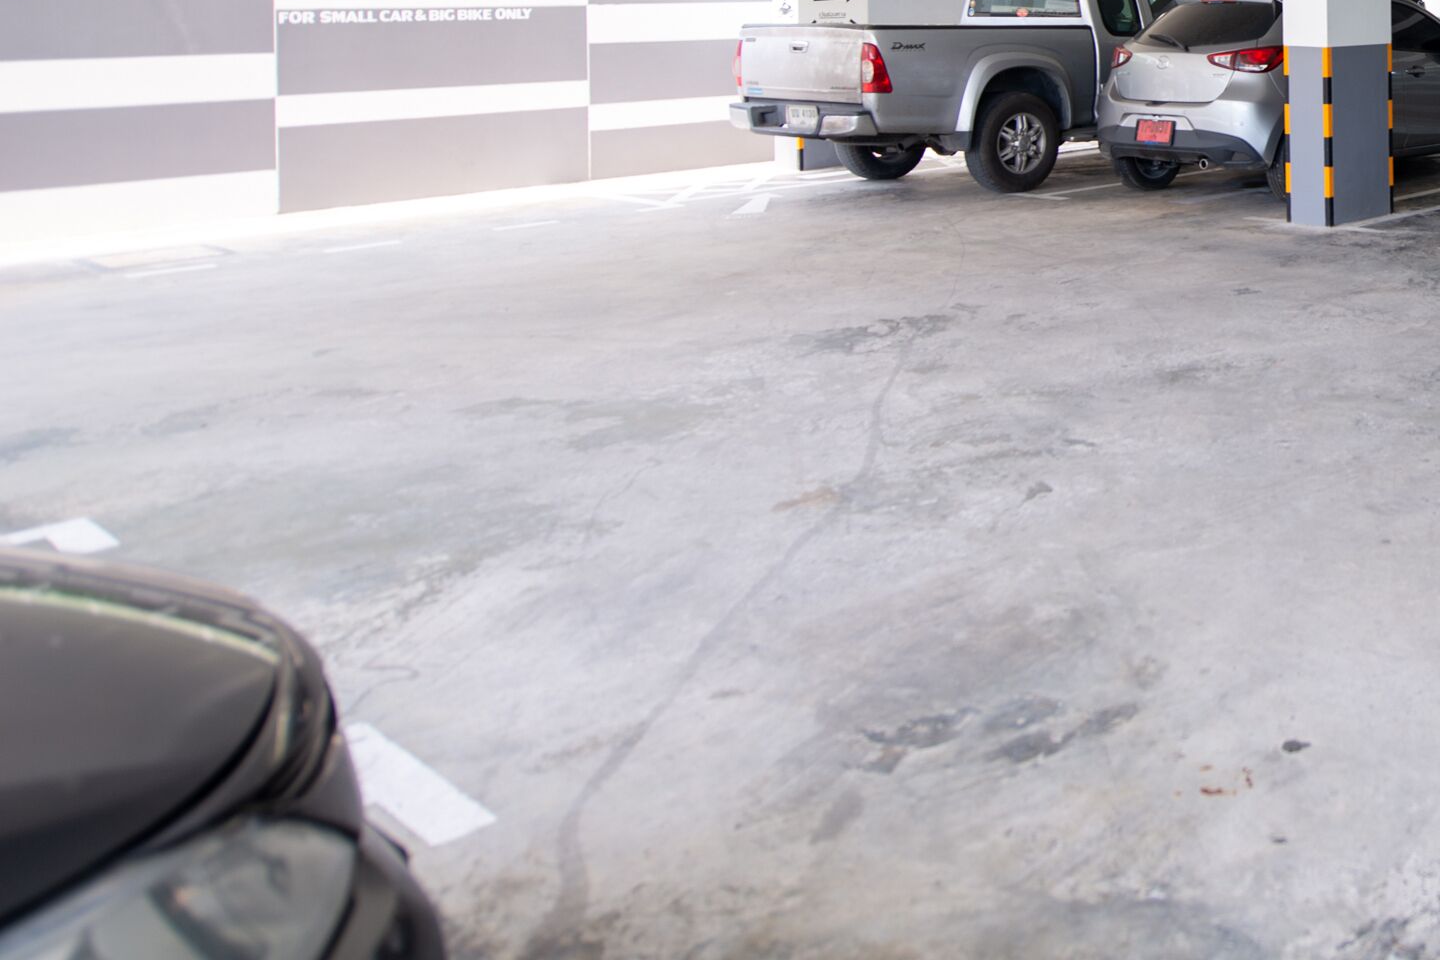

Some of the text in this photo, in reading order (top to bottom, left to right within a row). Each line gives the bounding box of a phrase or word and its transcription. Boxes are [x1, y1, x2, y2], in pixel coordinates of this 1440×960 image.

[278, 7, 533, 25] FOR SMALL CAR & BIG BIKE ONLY
